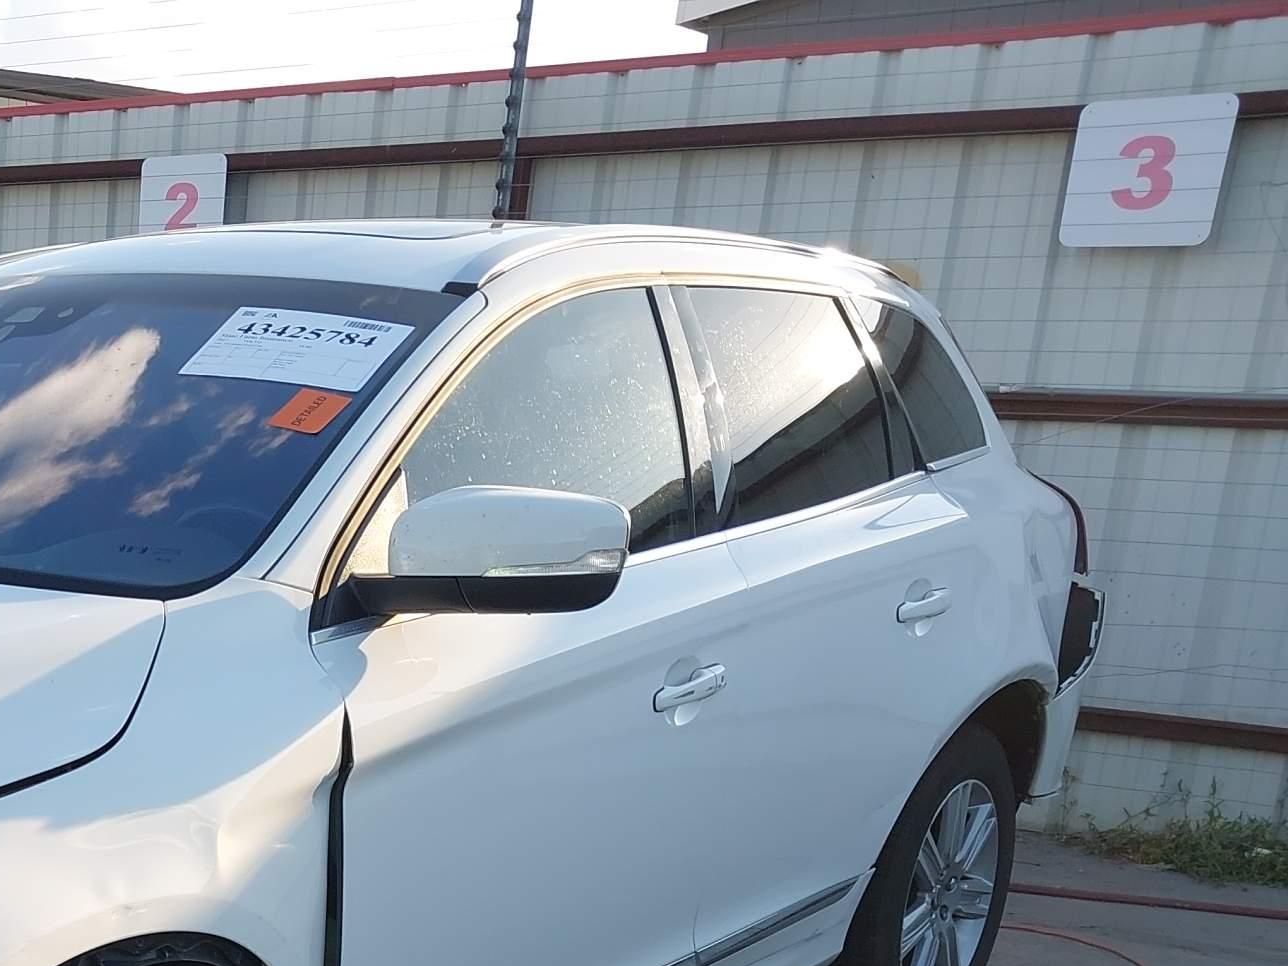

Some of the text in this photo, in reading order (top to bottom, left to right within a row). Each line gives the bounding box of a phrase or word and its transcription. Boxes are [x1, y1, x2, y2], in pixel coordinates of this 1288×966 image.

[1110, 135, 1176, 210] 3
[164, 182, 198, 231] 2
[237, 322, 377, 348] 43425784
[291, 395, 327, 426] DETAILED
